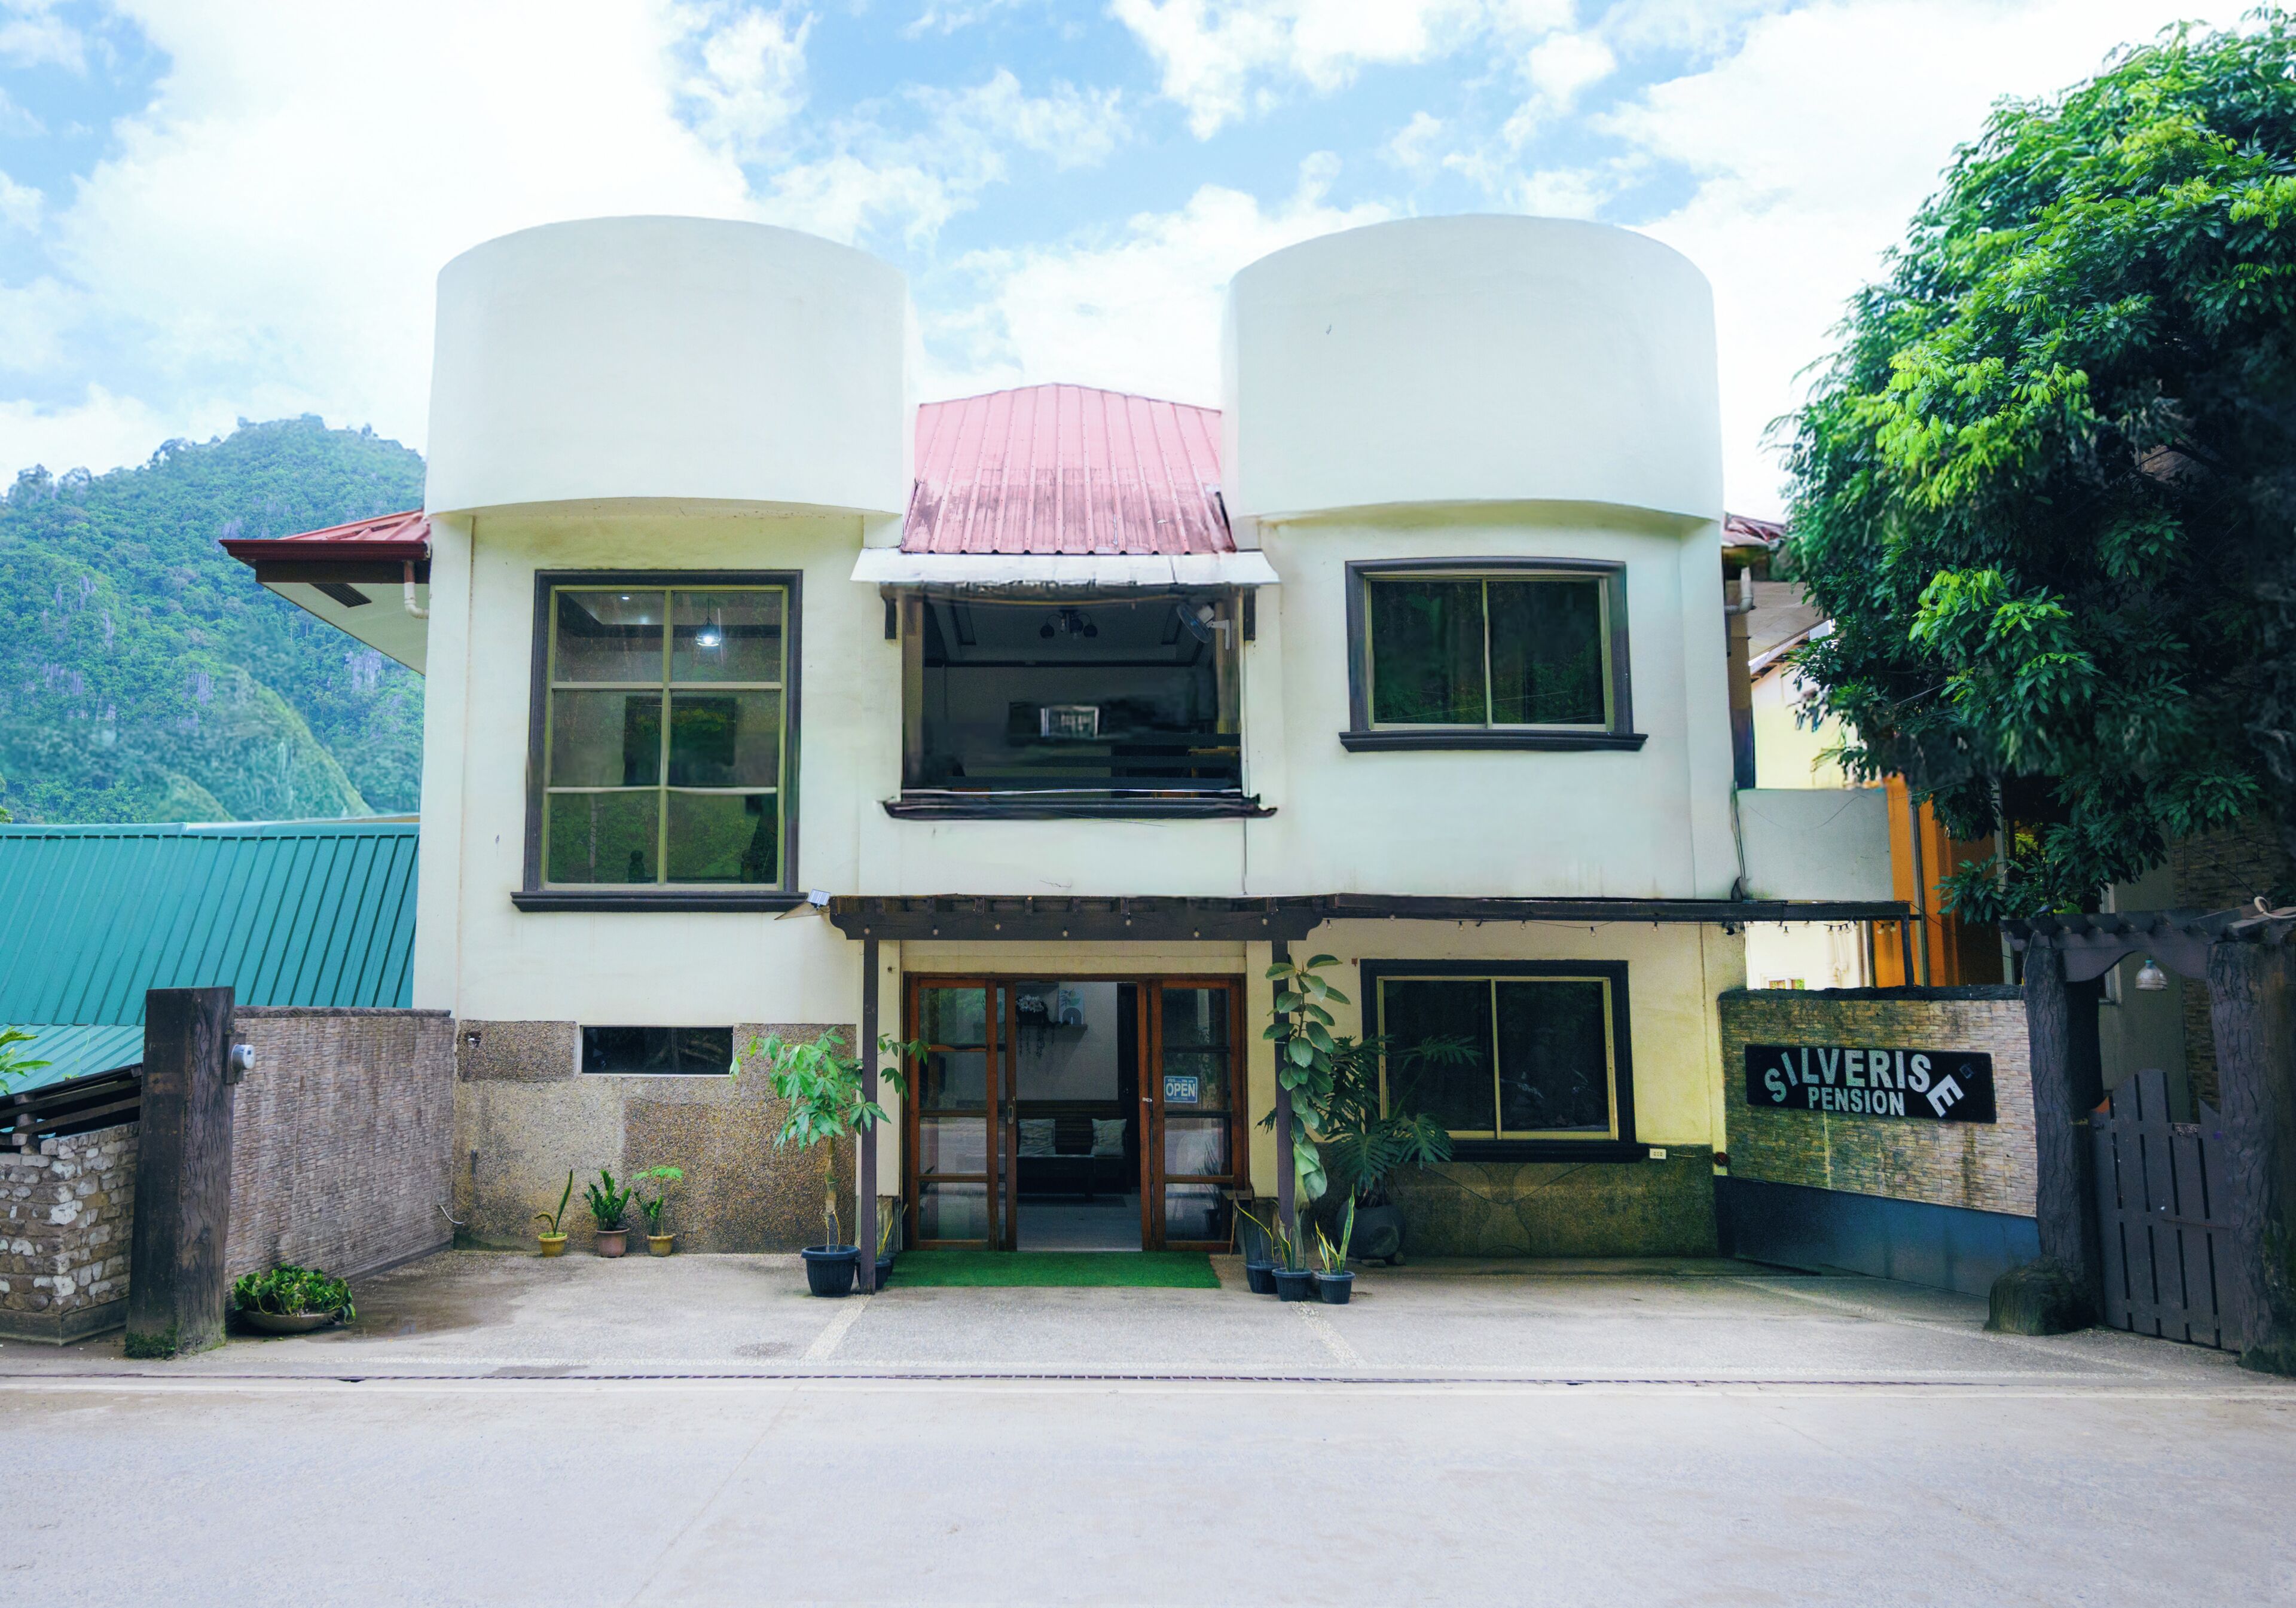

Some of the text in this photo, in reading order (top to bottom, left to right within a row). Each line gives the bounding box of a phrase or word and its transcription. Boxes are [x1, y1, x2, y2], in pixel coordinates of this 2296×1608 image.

[1166, 1083, 1195, 1097] OPEN
[1764, 1047, 1965, 1117] SILVERISE
[1808, 1086, 1906, 1116] PENSION
